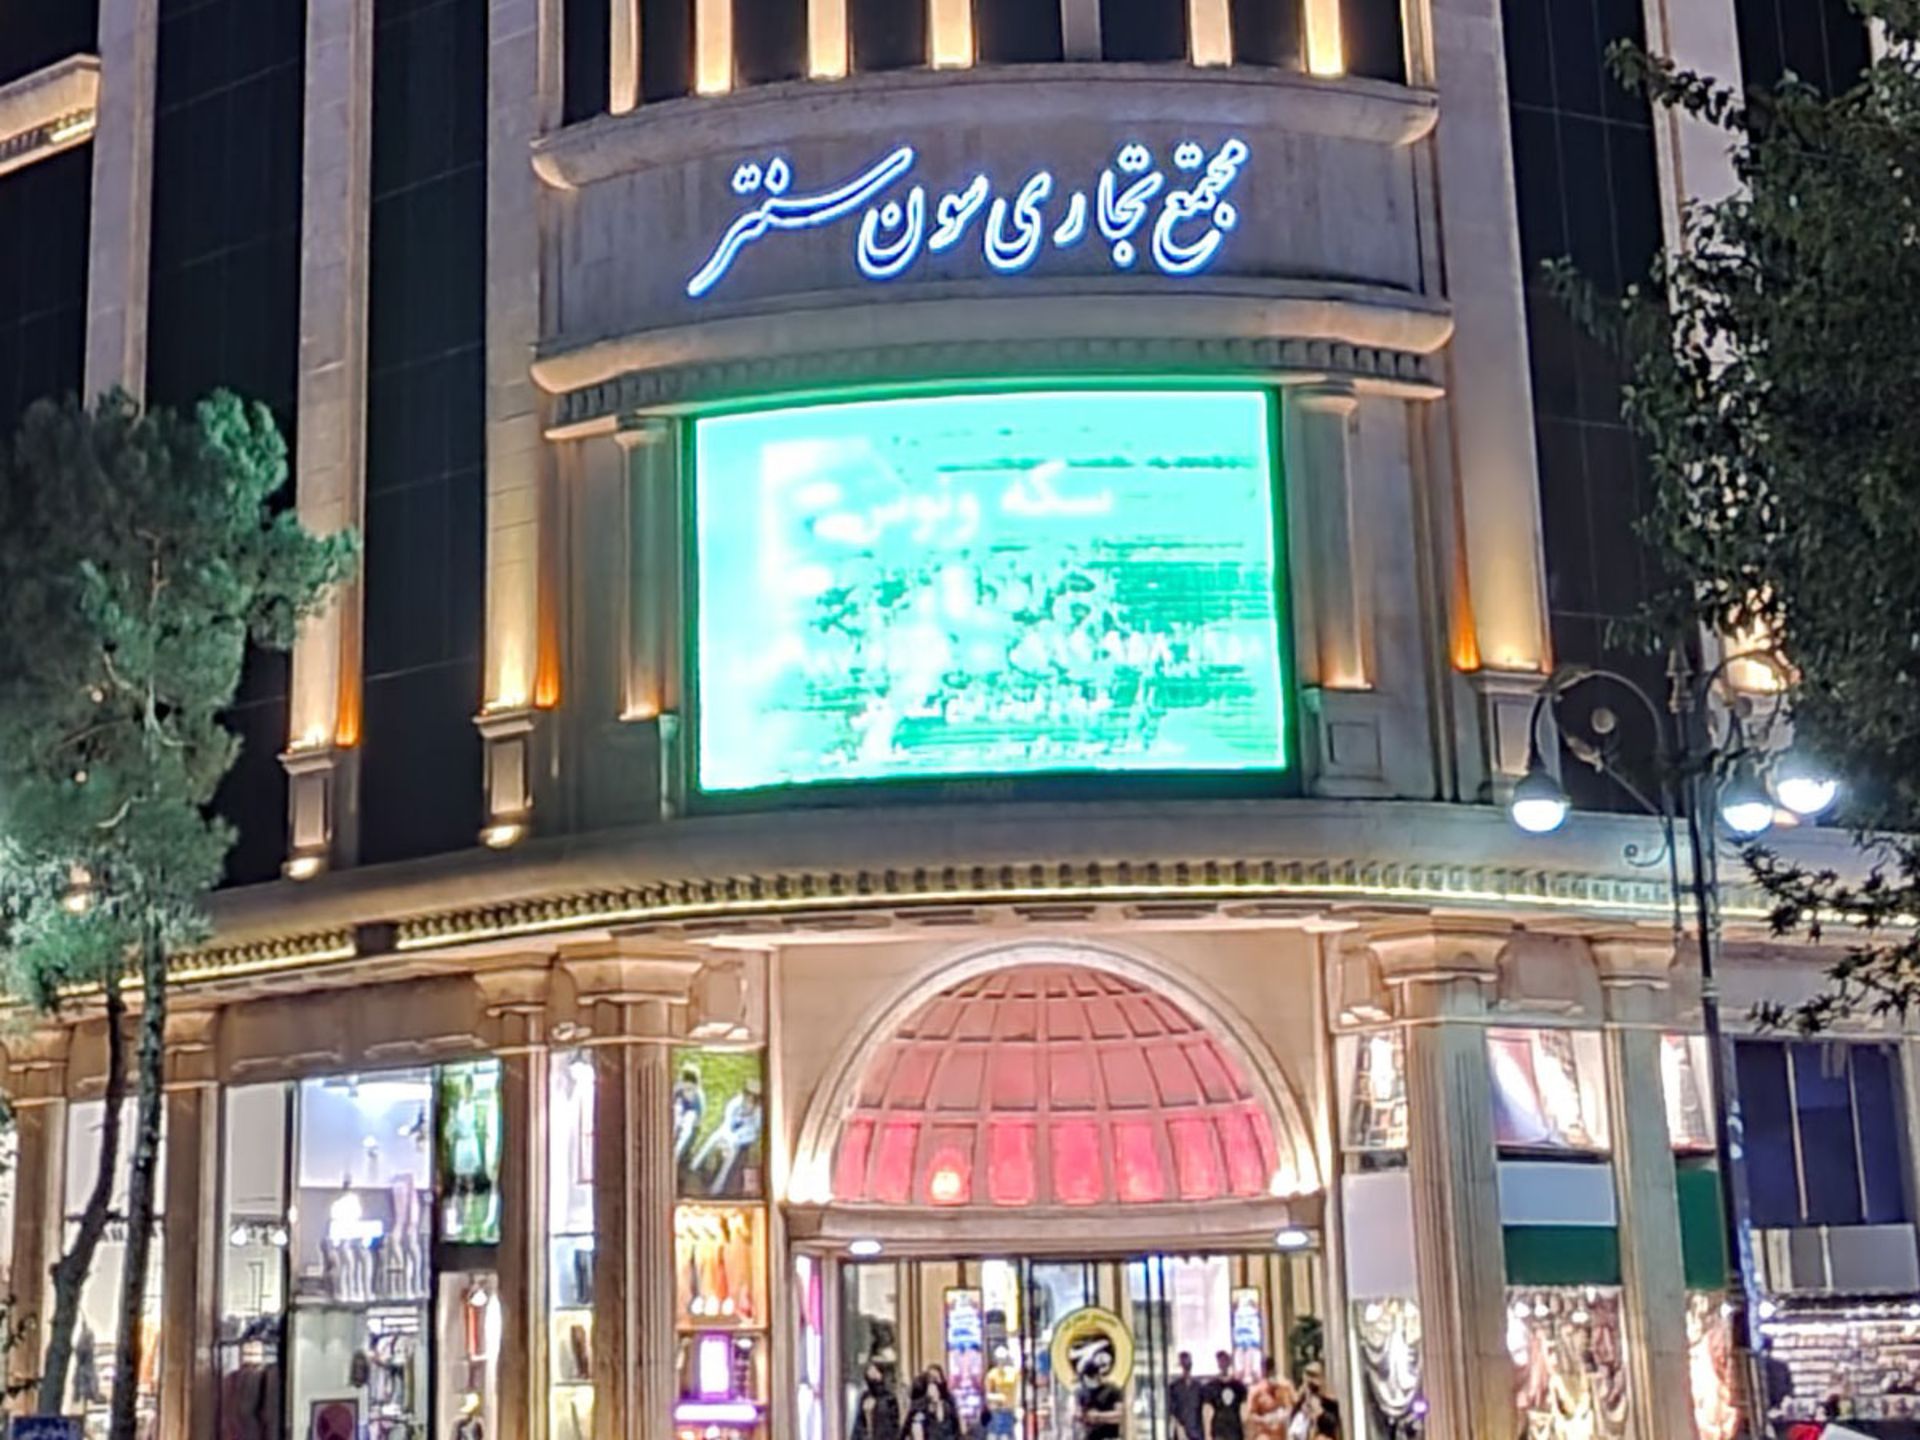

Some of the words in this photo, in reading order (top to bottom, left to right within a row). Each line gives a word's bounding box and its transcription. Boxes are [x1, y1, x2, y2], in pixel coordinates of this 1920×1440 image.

[686, 146, 915, 297] سنتر
[857, 173, 992, 280] سون
[984, 143, 1165, 274] تجاری
[1152, 138, 1250, 275] مجتمع
